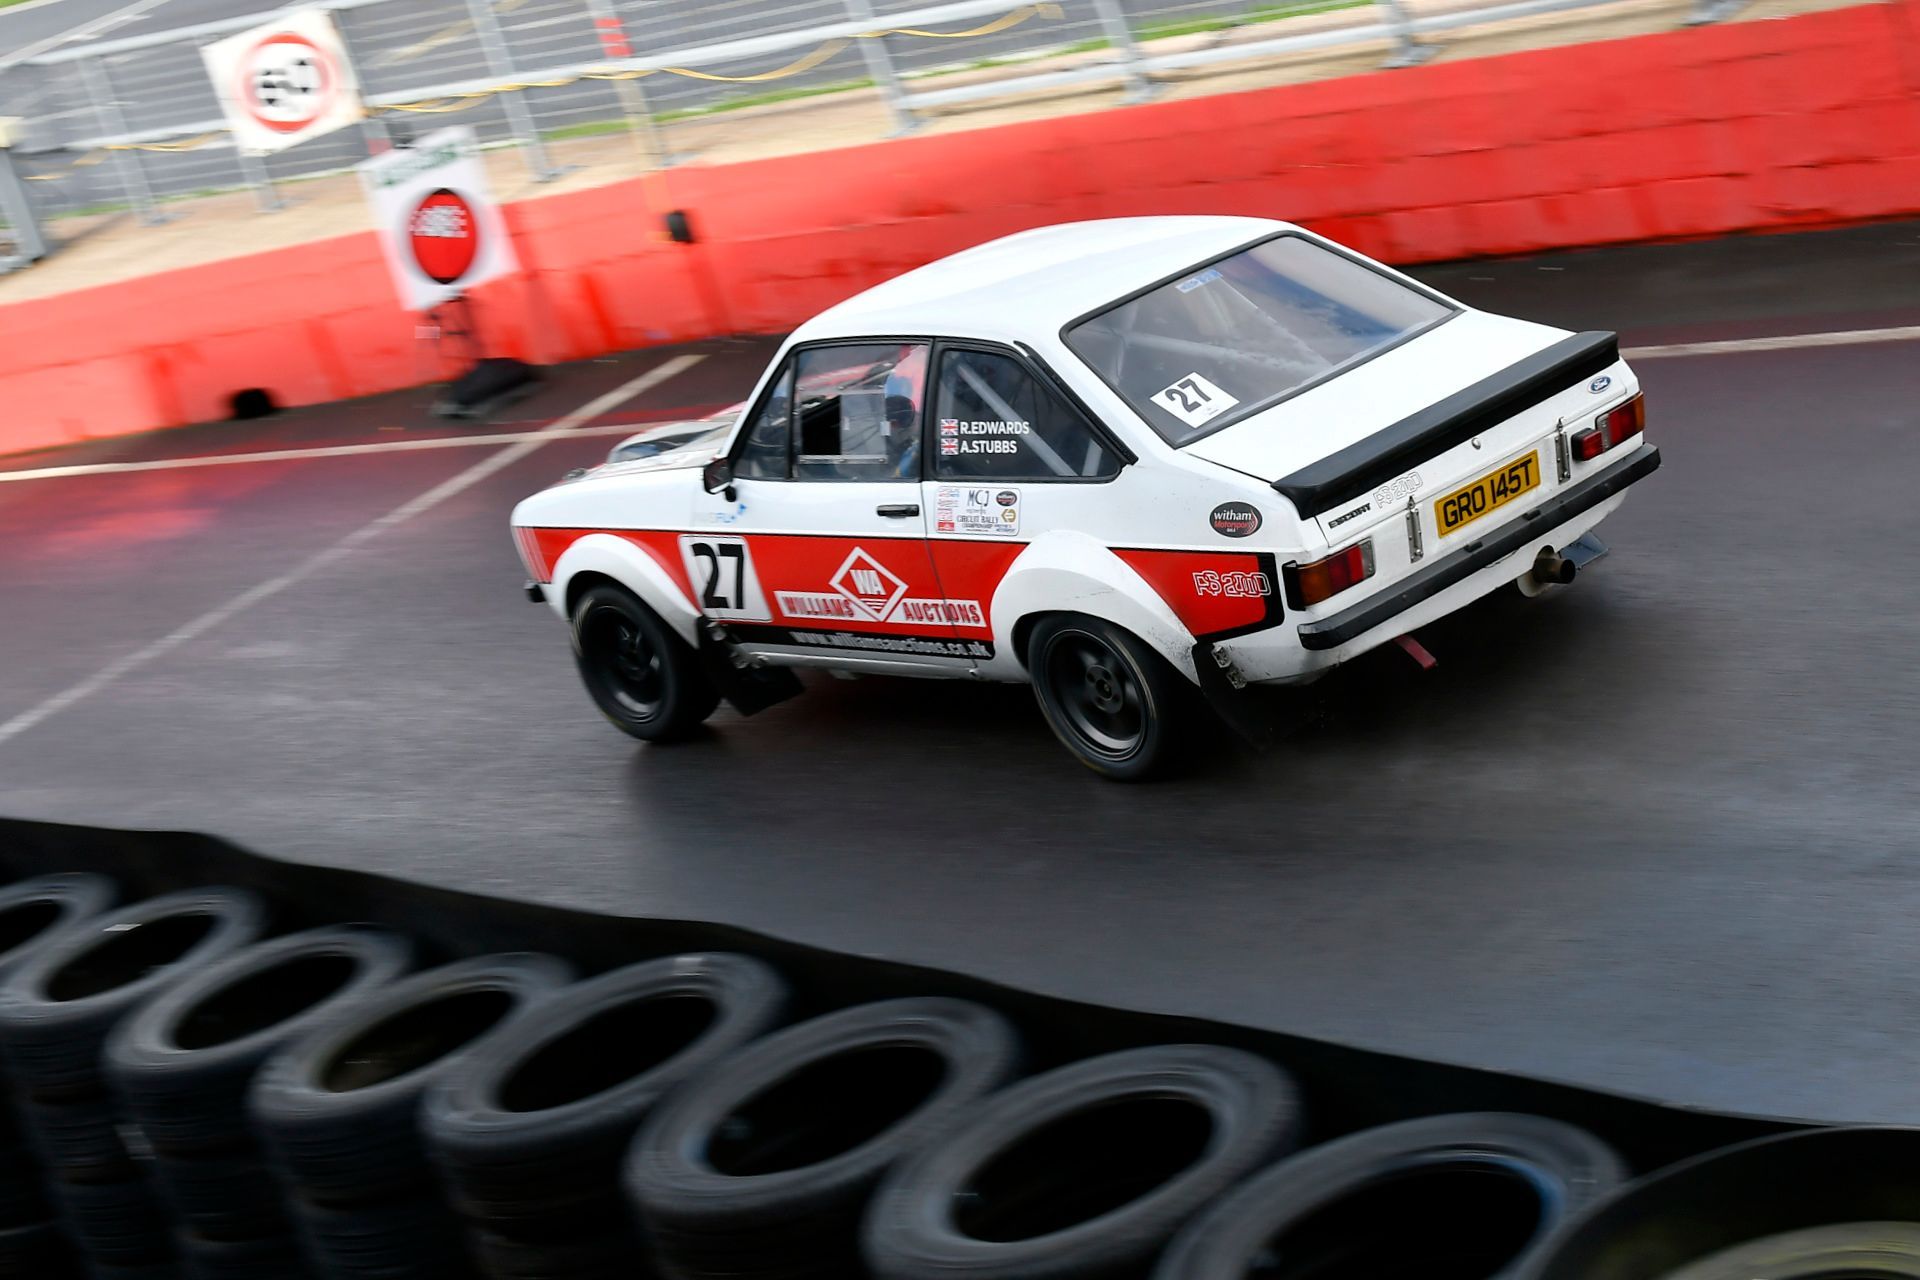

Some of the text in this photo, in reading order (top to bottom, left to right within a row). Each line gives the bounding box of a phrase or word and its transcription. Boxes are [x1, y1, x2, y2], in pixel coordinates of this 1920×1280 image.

[1165, 378, 1212, 413] 27
[960, 421, 1030, 435] R.EDWARDS
[960, 440, 1018, 454] A.STUBBS
[1443, 458, 1532, 528] GRO 145T
[1214, 509, 1252, 520] witham
[1328, 503, 1371, 529] ESCORT
[1373, 486, 1394, 509] RS
[690, 543, 745, 610] 27
[850, 569, 886, 595] WA
[1193, 570, 1272, 597] RS 2000
[782, 596, 981, 624] WILLIAMS AUCTIONS
